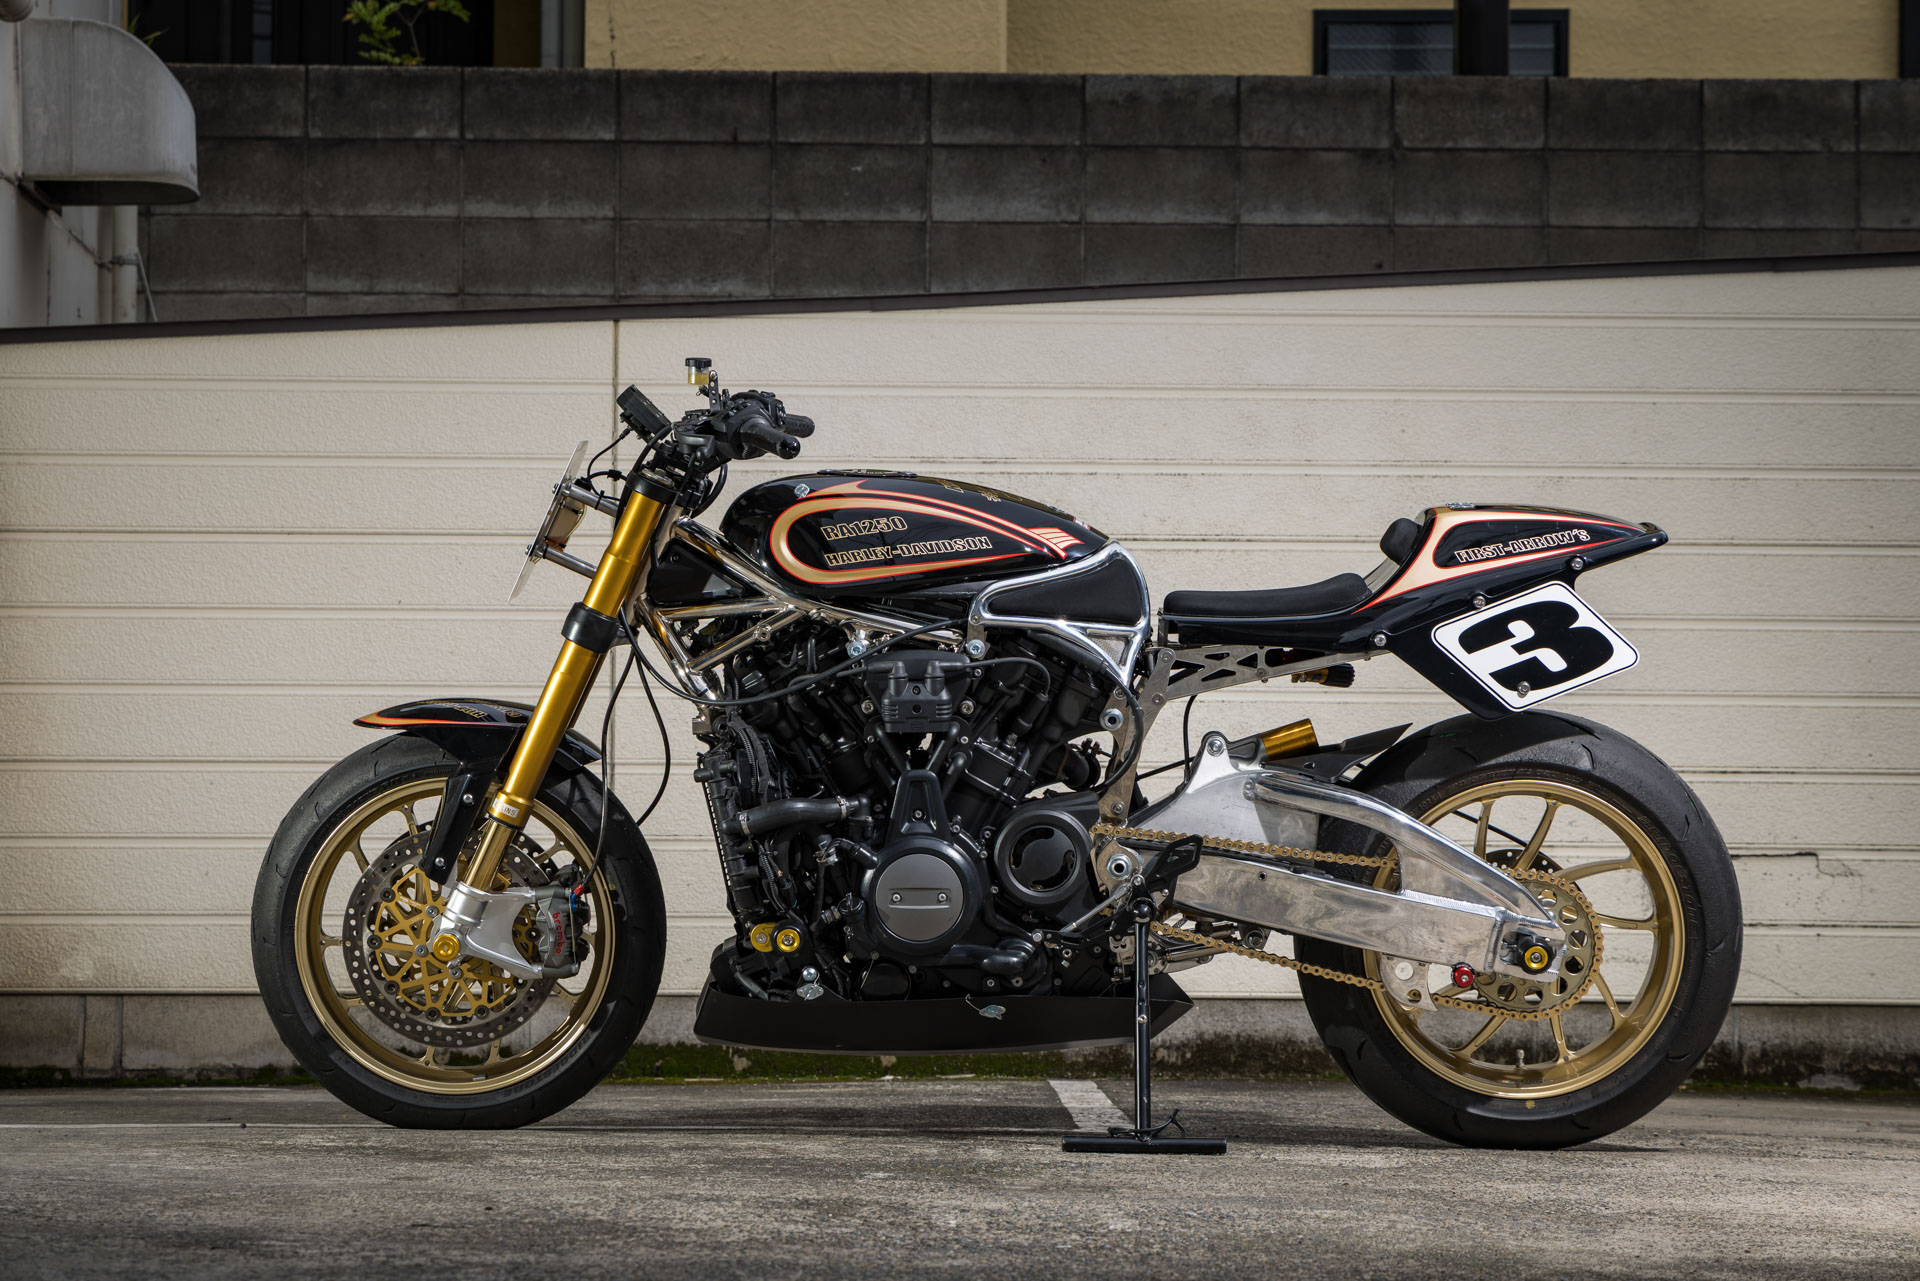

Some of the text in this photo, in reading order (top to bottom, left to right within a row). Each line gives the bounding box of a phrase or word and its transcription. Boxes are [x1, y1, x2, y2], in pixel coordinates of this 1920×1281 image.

[820, 516, 908, 541] RA1250
[1454, 529, 1591, 562] FIRST-ARROW'S
[824, 536, 993, 567] HARLEY-DAVIDSON
[1458, 600, 1614, 692] 3
[552, 911, 566, 954] brembo
[503, 1028, 595, 1097] RIDGESTONE
